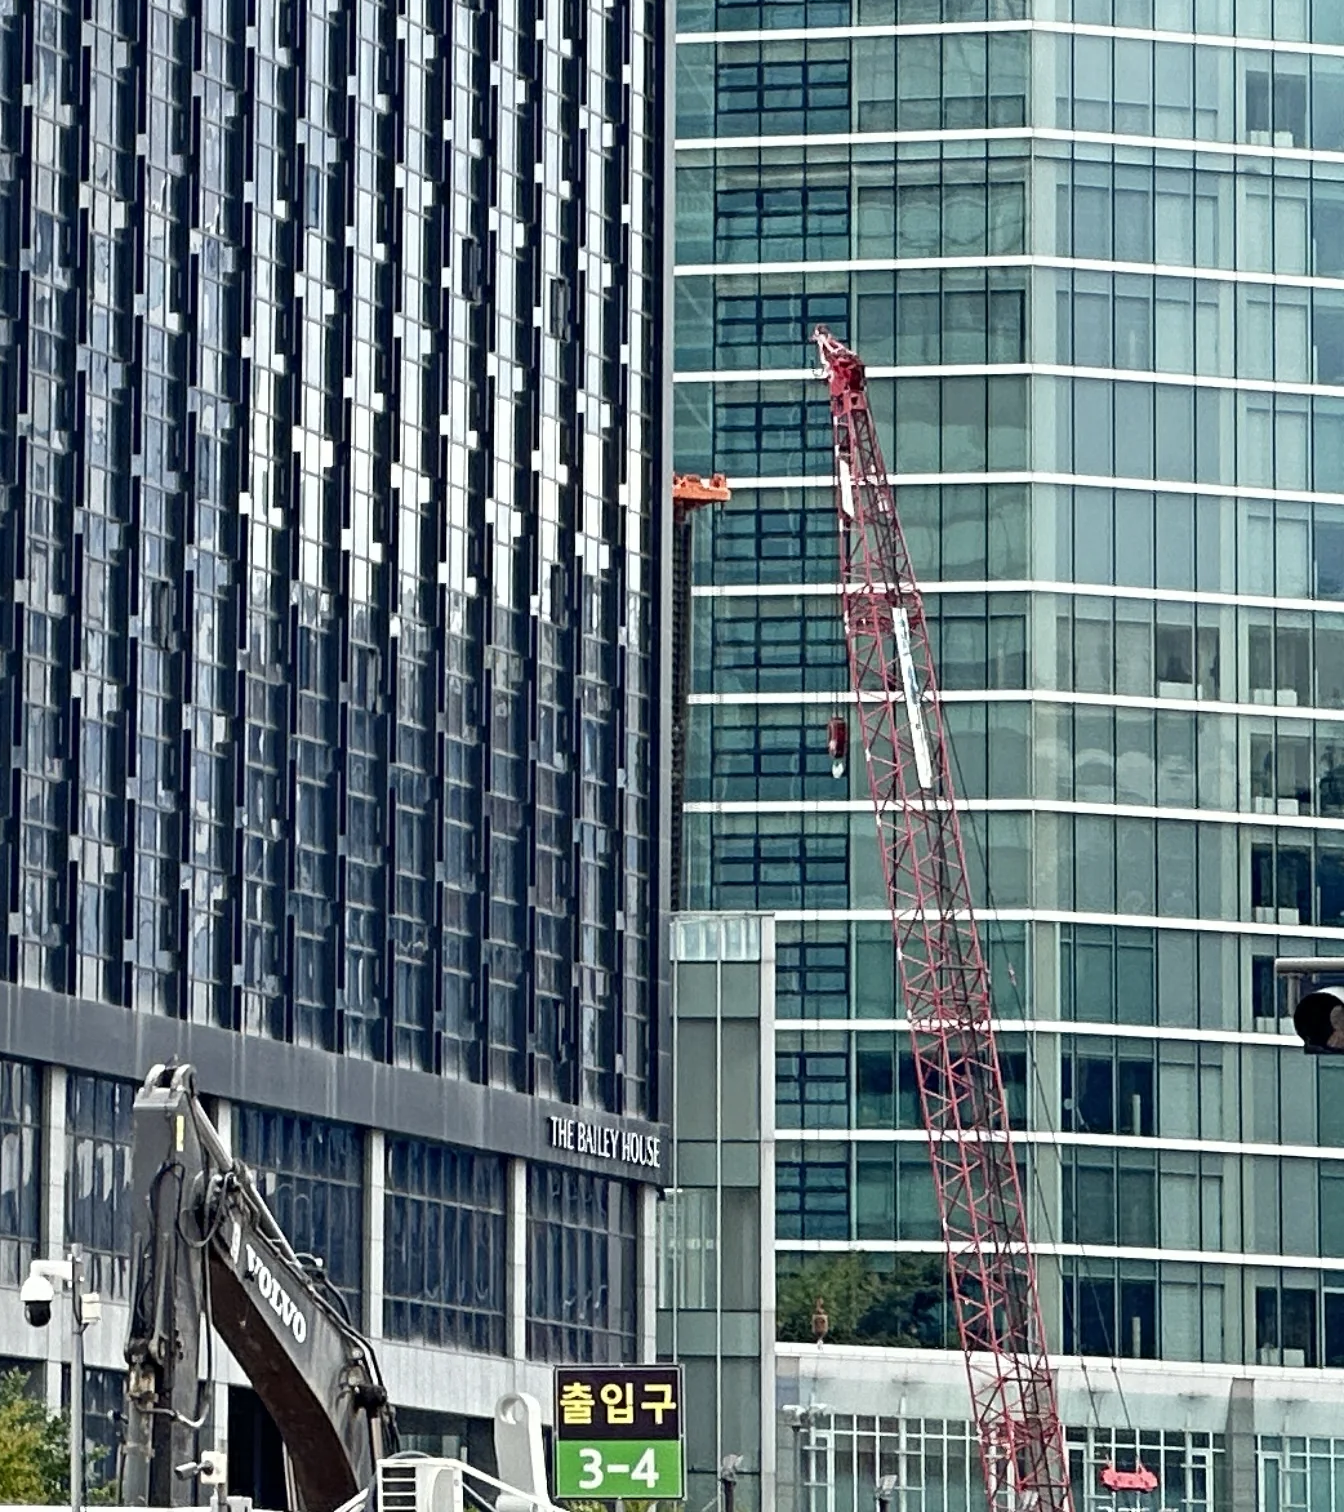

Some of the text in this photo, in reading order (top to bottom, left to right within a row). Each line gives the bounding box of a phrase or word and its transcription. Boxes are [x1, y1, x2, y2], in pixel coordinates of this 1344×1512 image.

[550, 1115, 661, 1169] THE BAILEY HOUSE
[245, 1243, 307, 1344] VOLVO
[560, 1381, 677, 1425] 출입구
[578, 1447, 660, 1490] 3-4
